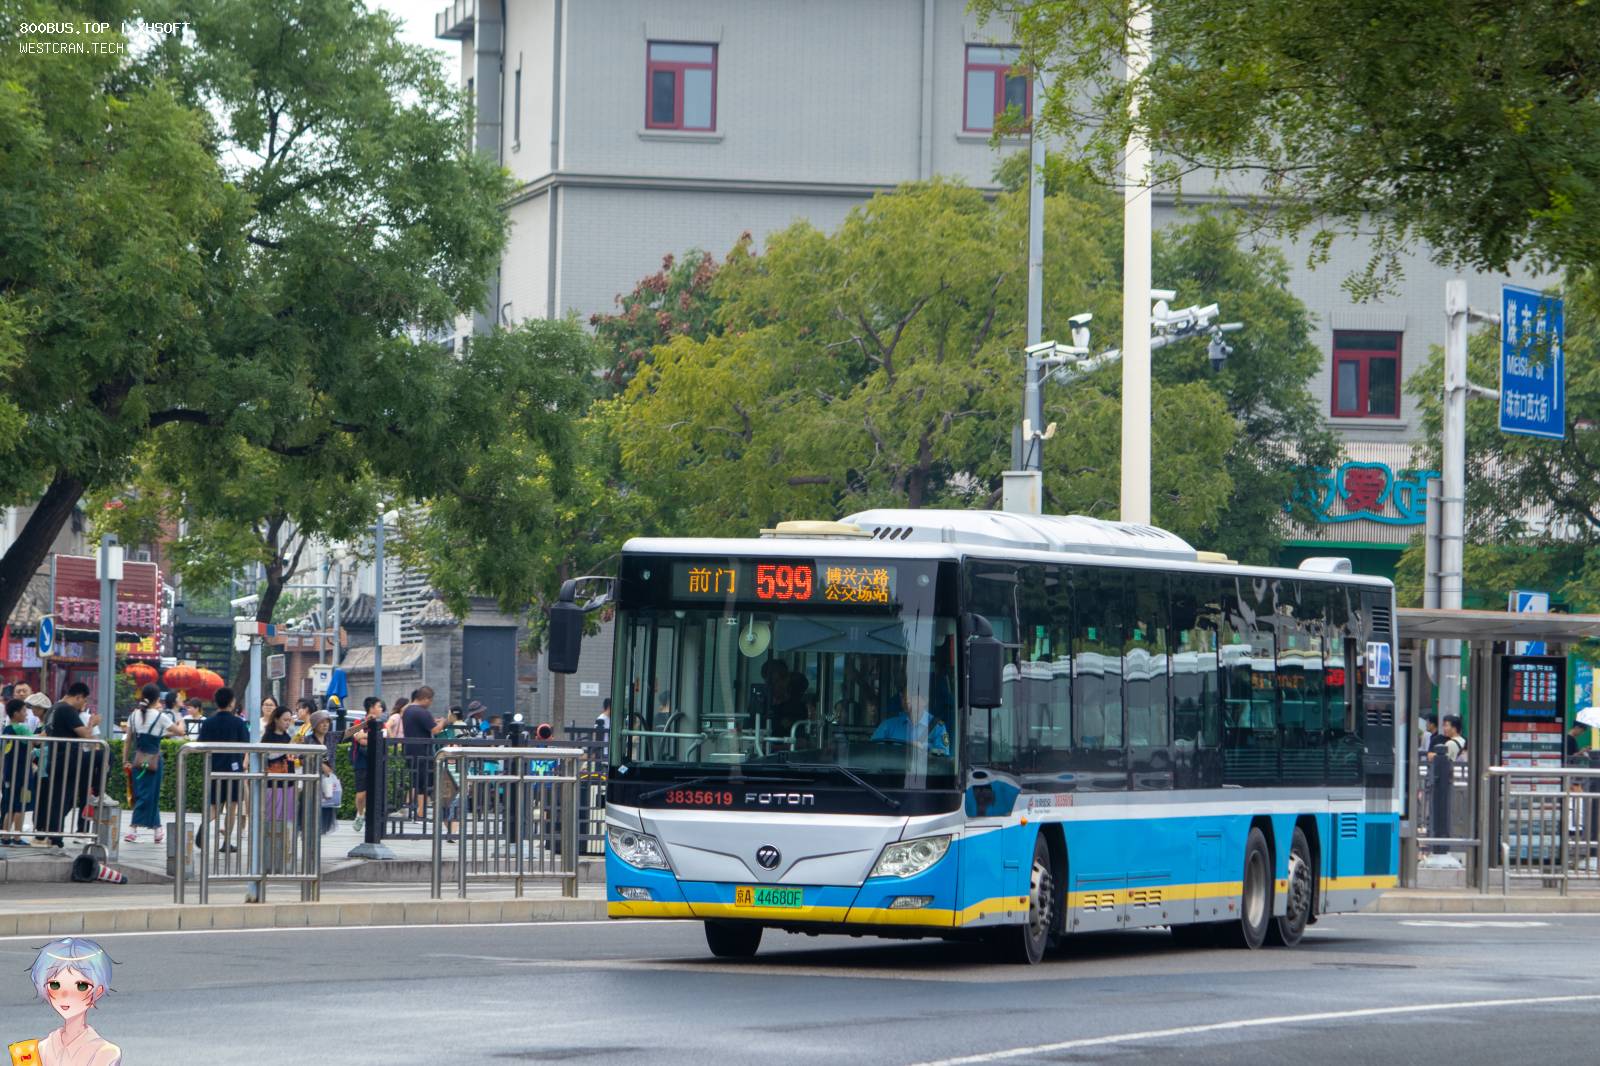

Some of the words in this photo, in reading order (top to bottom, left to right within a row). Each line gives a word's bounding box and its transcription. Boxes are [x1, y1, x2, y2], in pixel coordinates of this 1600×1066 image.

[688, 567, 736, 593] 前门
[756, 565, 813, 600] 599
[825, 567, 890, 586] 博兴六路
[825, 586, 889, 603] 公交场站
[665, 790, 733, 805] 3835619
[744, 793, 814, 805] FOTON
